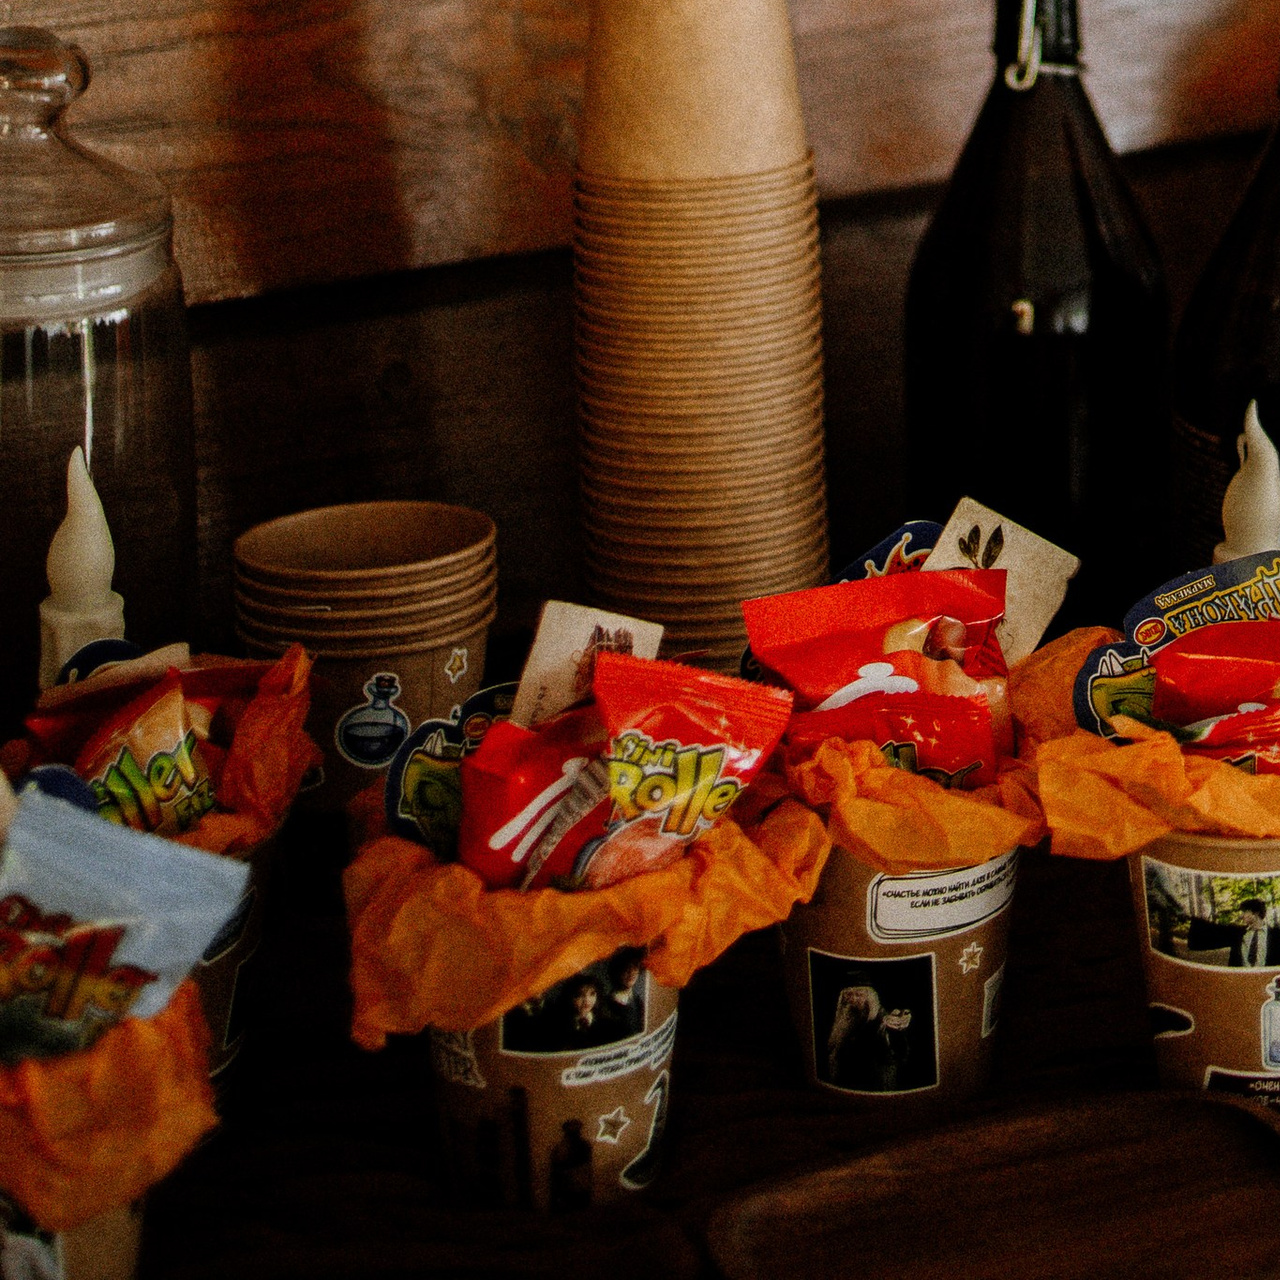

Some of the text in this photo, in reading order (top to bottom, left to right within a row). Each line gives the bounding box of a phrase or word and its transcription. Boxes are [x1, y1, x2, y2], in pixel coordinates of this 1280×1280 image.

[948, 880, 970, 894] НАЙТИ
[910, 898, 931, 909] ЕСЛИ
[931, 897, 941, 907] НЕ
